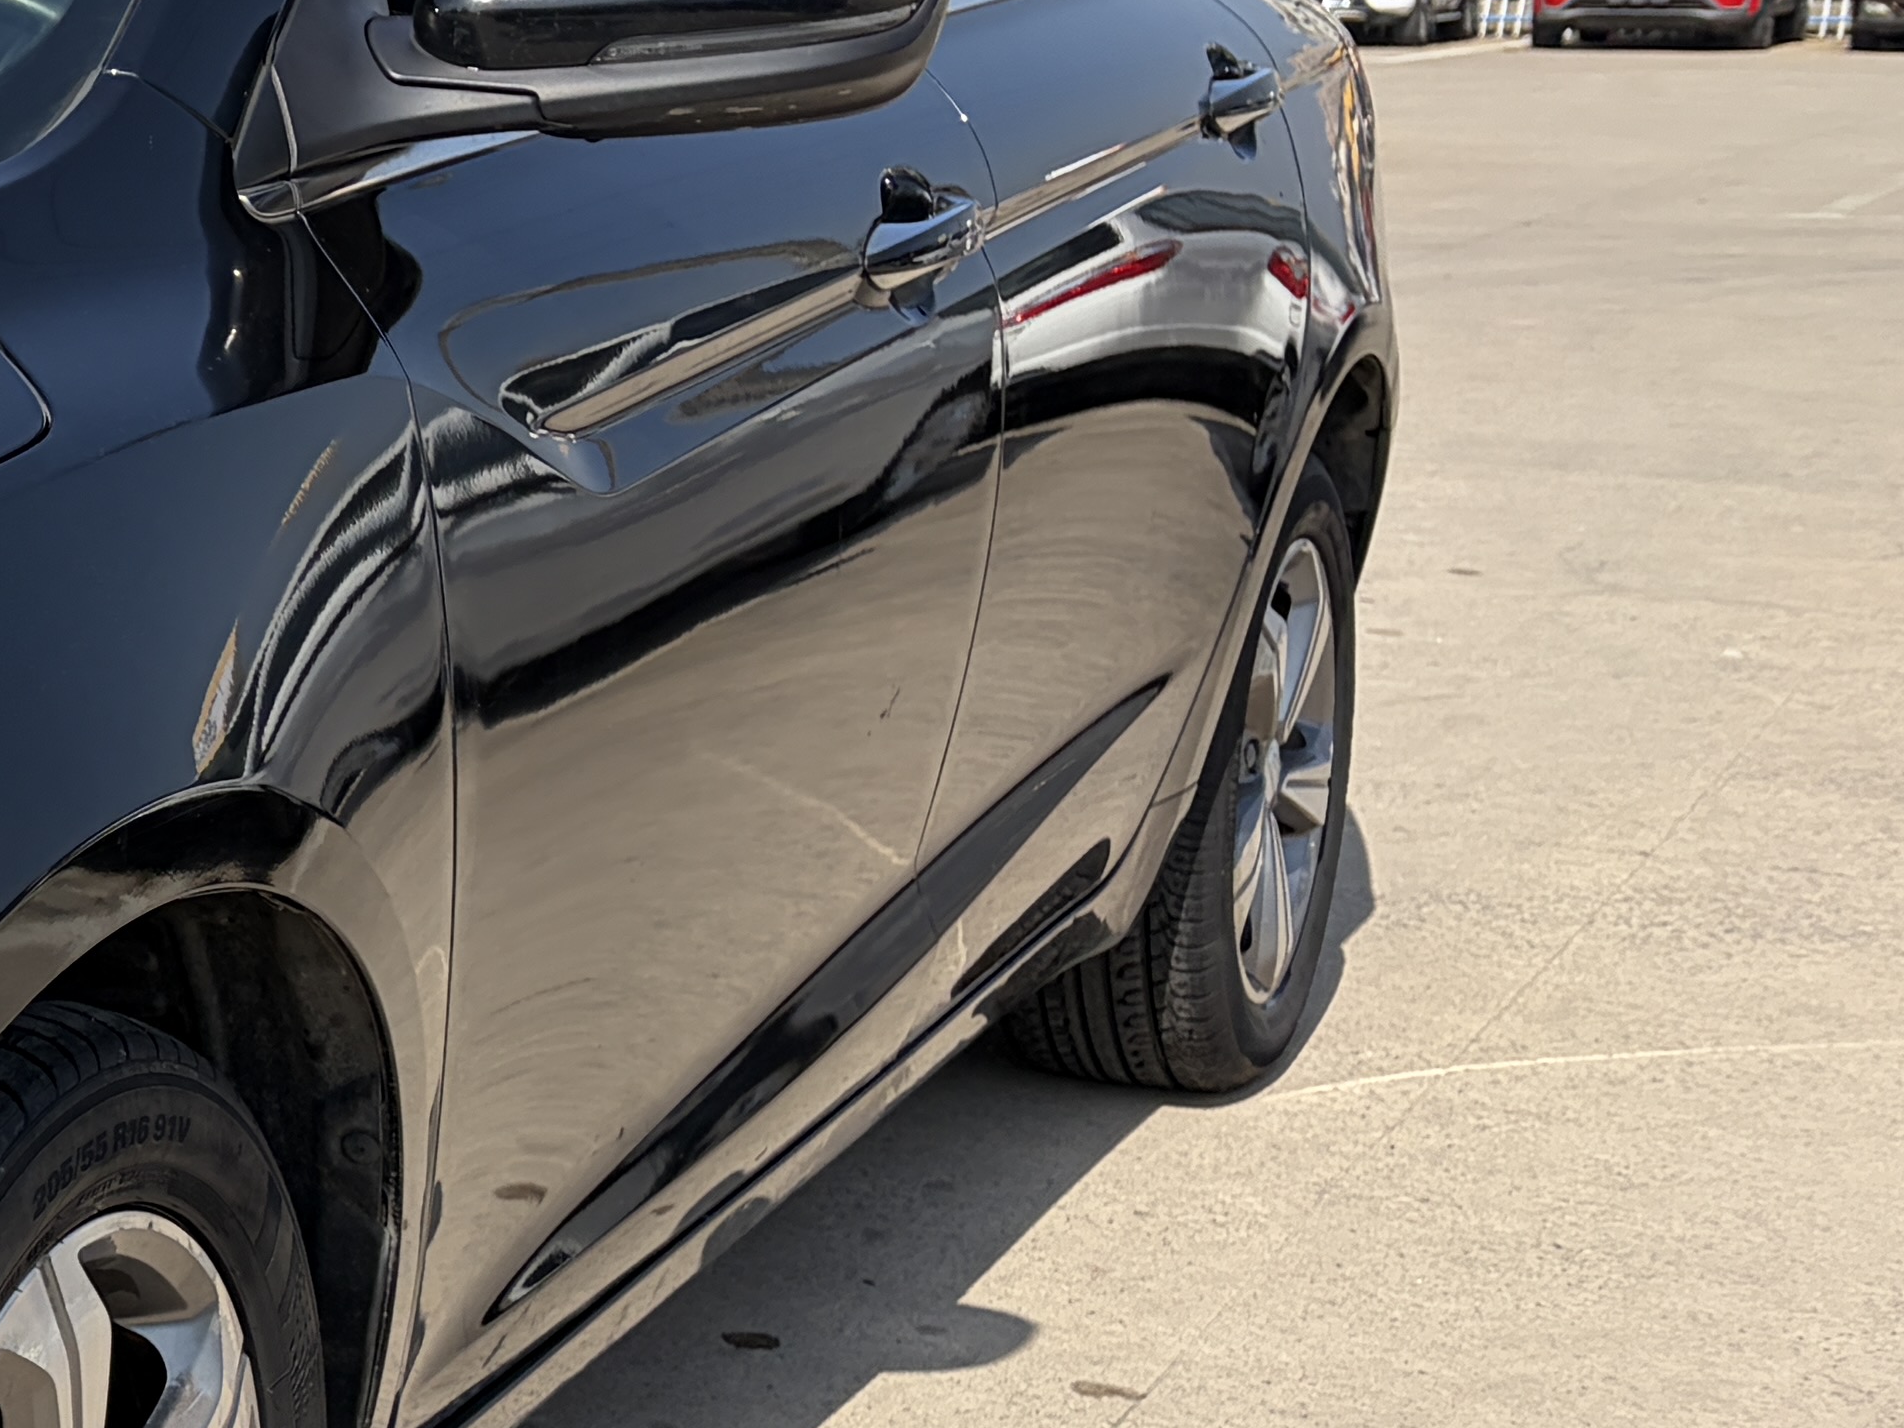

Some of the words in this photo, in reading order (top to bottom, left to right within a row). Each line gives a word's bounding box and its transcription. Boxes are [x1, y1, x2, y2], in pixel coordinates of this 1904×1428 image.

[32, 1130, 110, 1222] 205/55
[112, 1114, 151, 1154] R16
[152, 1113, 191, 1144] 91V
